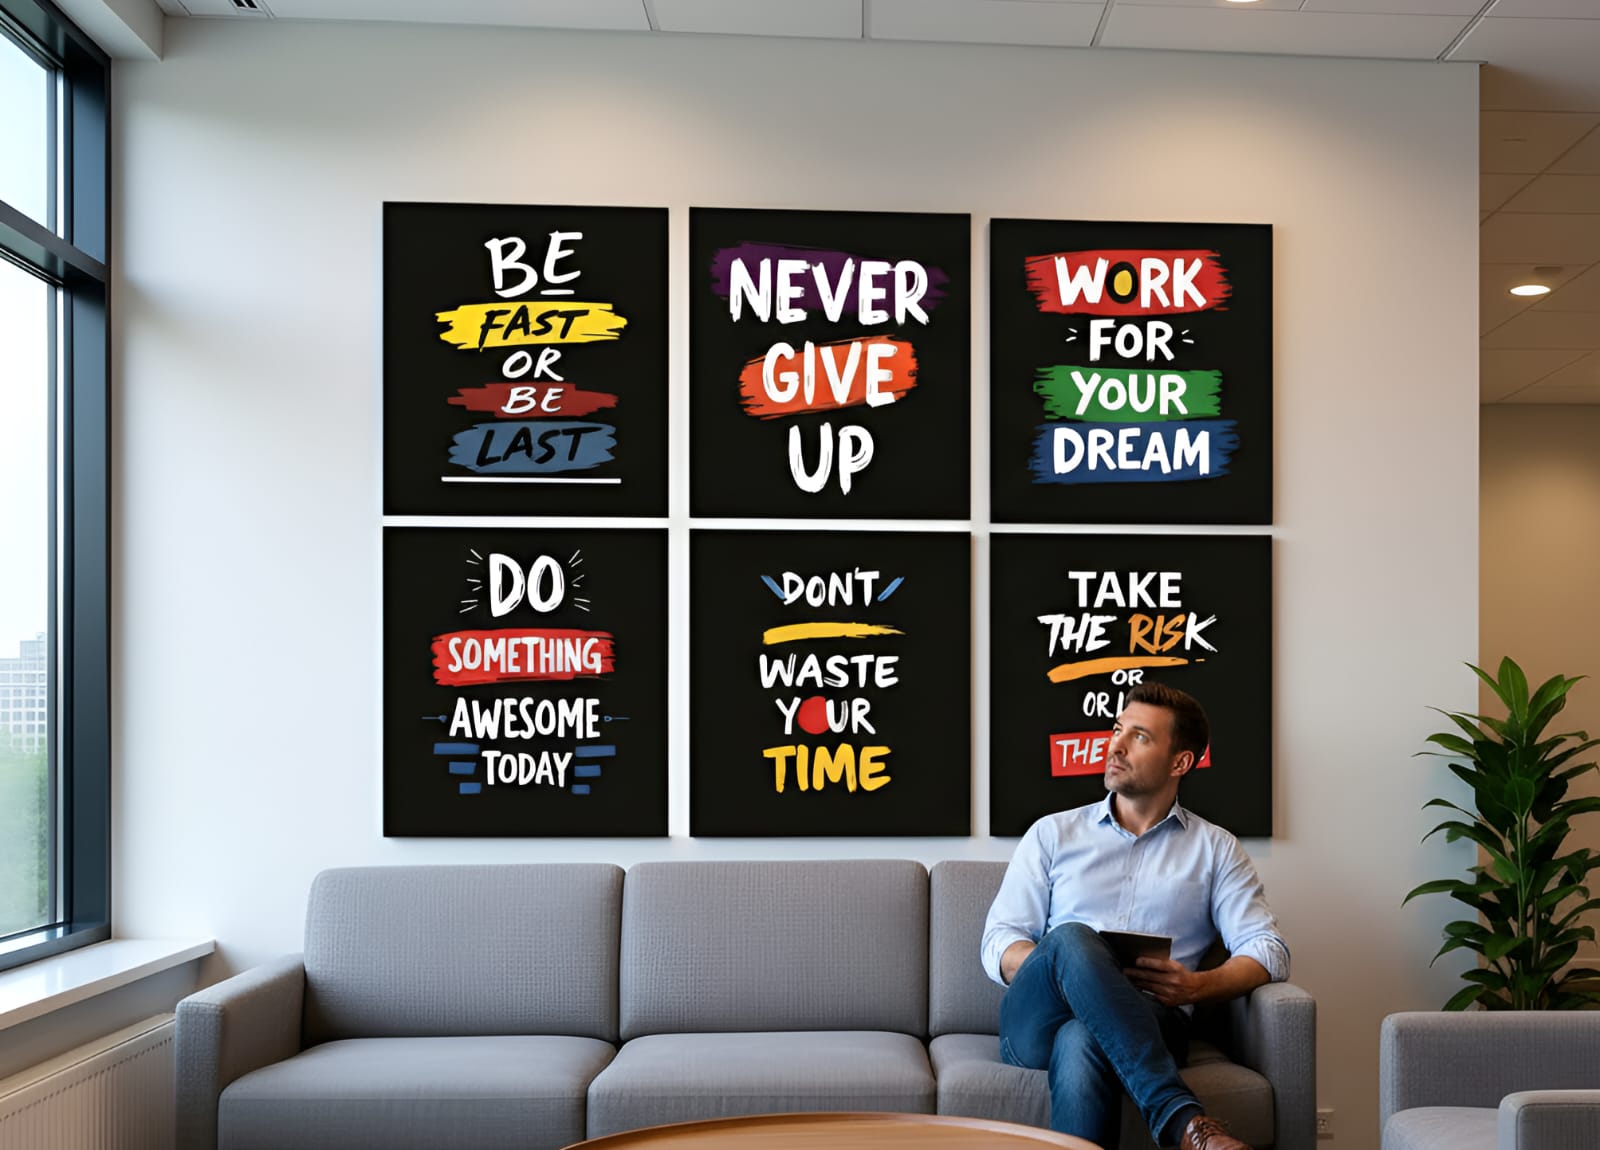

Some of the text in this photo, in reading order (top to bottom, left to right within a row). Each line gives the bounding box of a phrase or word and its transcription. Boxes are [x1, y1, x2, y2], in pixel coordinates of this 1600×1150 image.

[484, 231, 583, 298] BE
[1054, 256, 1207, 308] WORK
[729, 257, 930, 326] NEVER
[479, 305, 590, 352] FAST
[1089, 318, 1175, 362] FOR
[502, 347, 564, 381] OR
[762, 340, 898, 408] GIVE
[501, 386, 564, 414] BE
[1070, 371, 1188, 415] YOUR
[476, 426, 603, 467] LAST
[788, 422, 874, 496] UP
[1053, 427, 1210, 476] DREAM
[489, 553, 565, 617] DO
[1068, 571, 1182, 608] TAKE
[448, 636, 602, 674] SOMETHING
[1037, 611, 1218, 658] THE RISK
[759, 653, 899, 688] WASTE
[1111, 669, 1144, 687] OR
[449, 697, 601, 740] AWESOME
[1082, 691, 1114, 718] OR
[481, 750, 573, 788] TODAY
[762, 742, 892, 793] TIME
